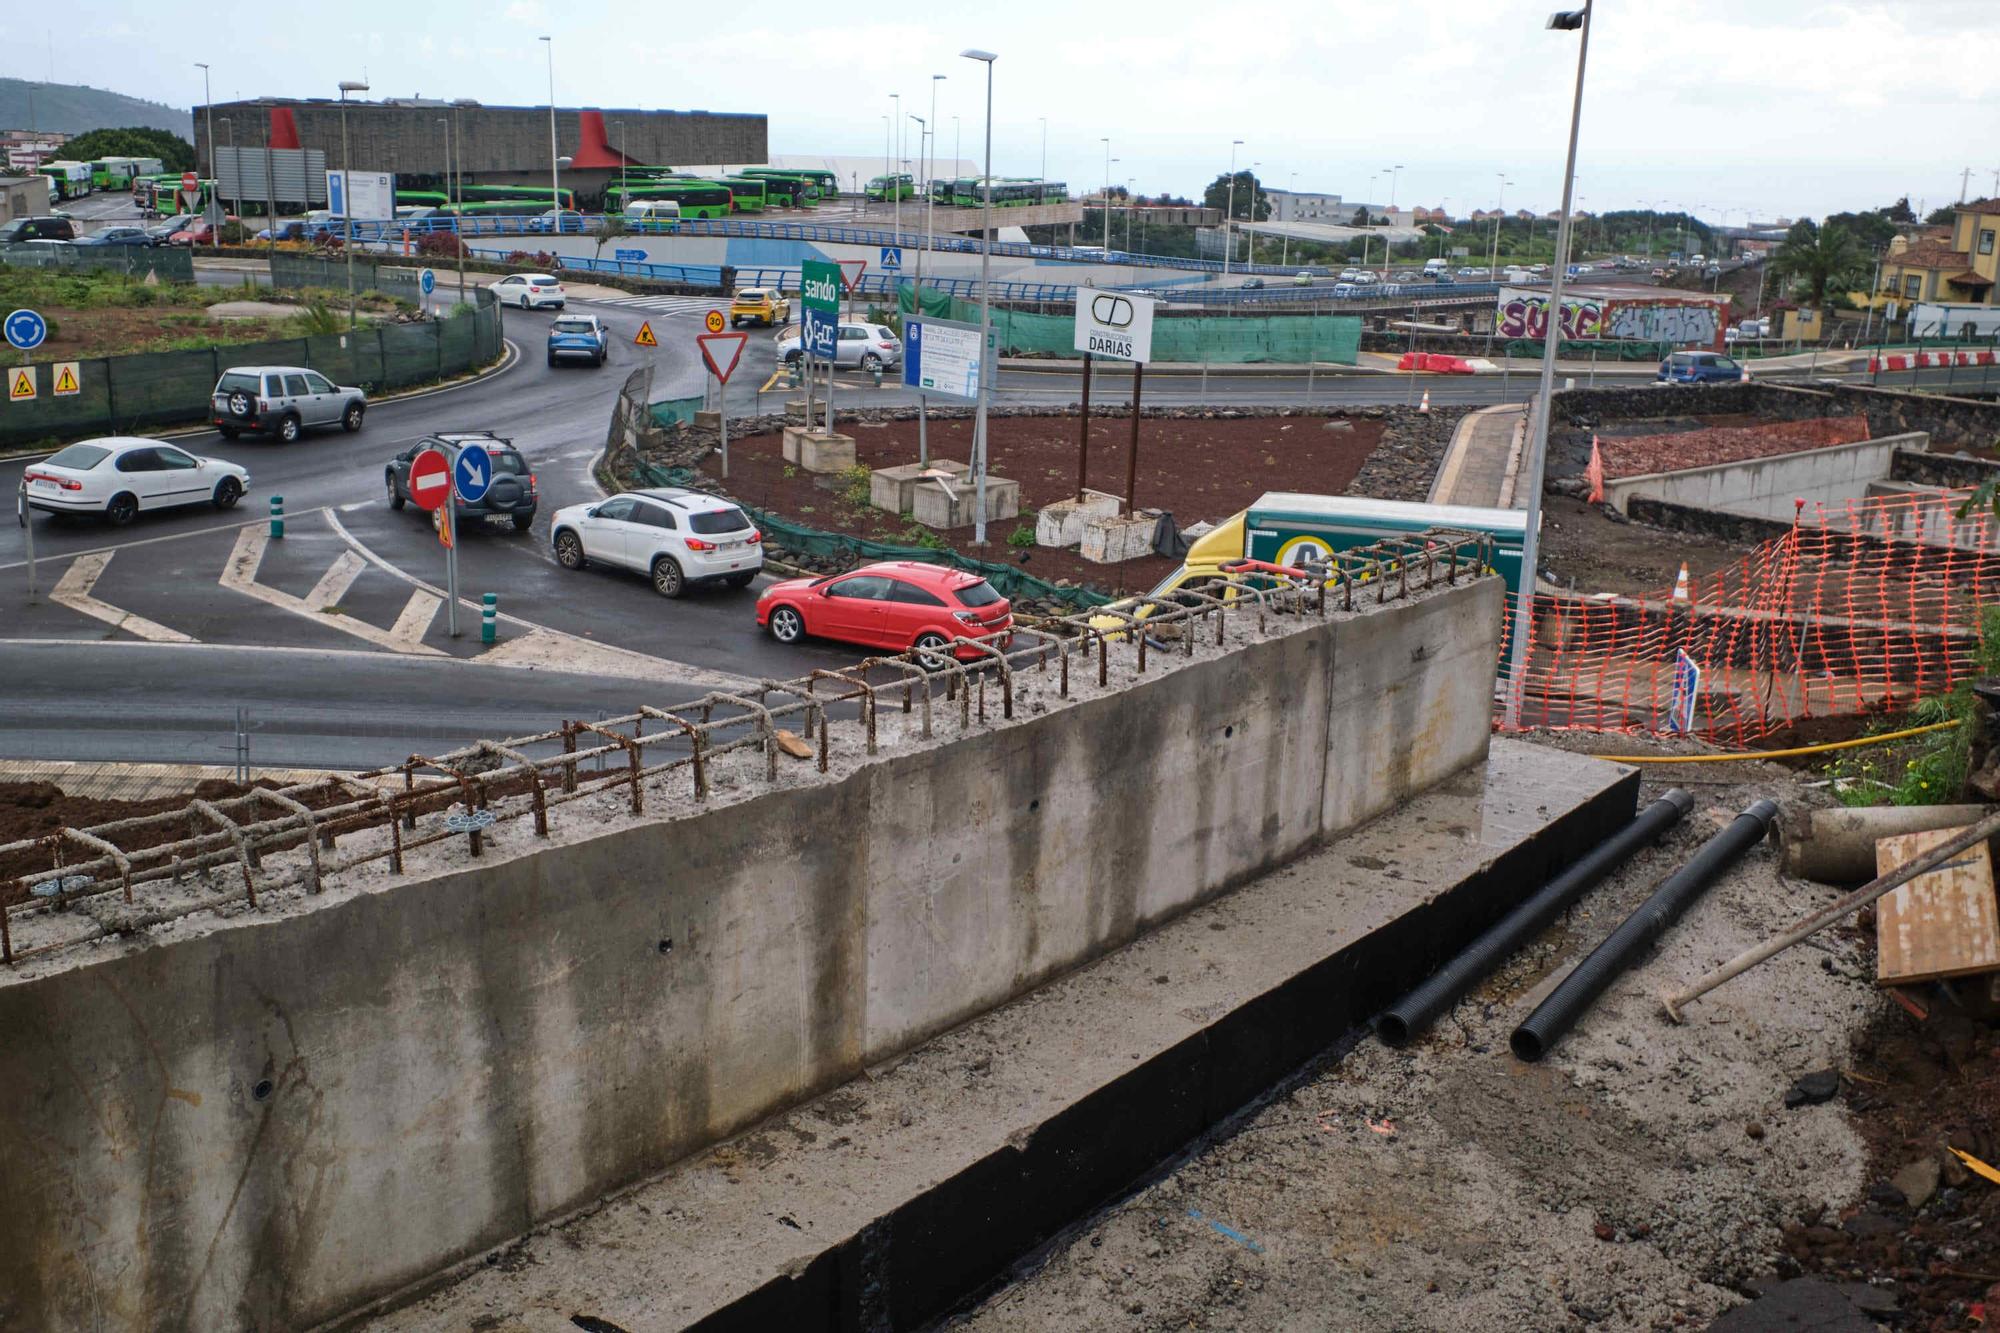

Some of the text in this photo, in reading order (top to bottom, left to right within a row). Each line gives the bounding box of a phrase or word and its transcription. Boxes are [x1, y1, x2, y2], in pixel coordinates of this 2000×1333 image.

[805, 273, 836, 302] sando
[709, 317, 721, 326] 30
[1500, 300, 1601, 340] SURE
[1089, 336, 1132, 357] DARIAS
[1090, 329, 1133, 343] CONSTRUCCIONES
